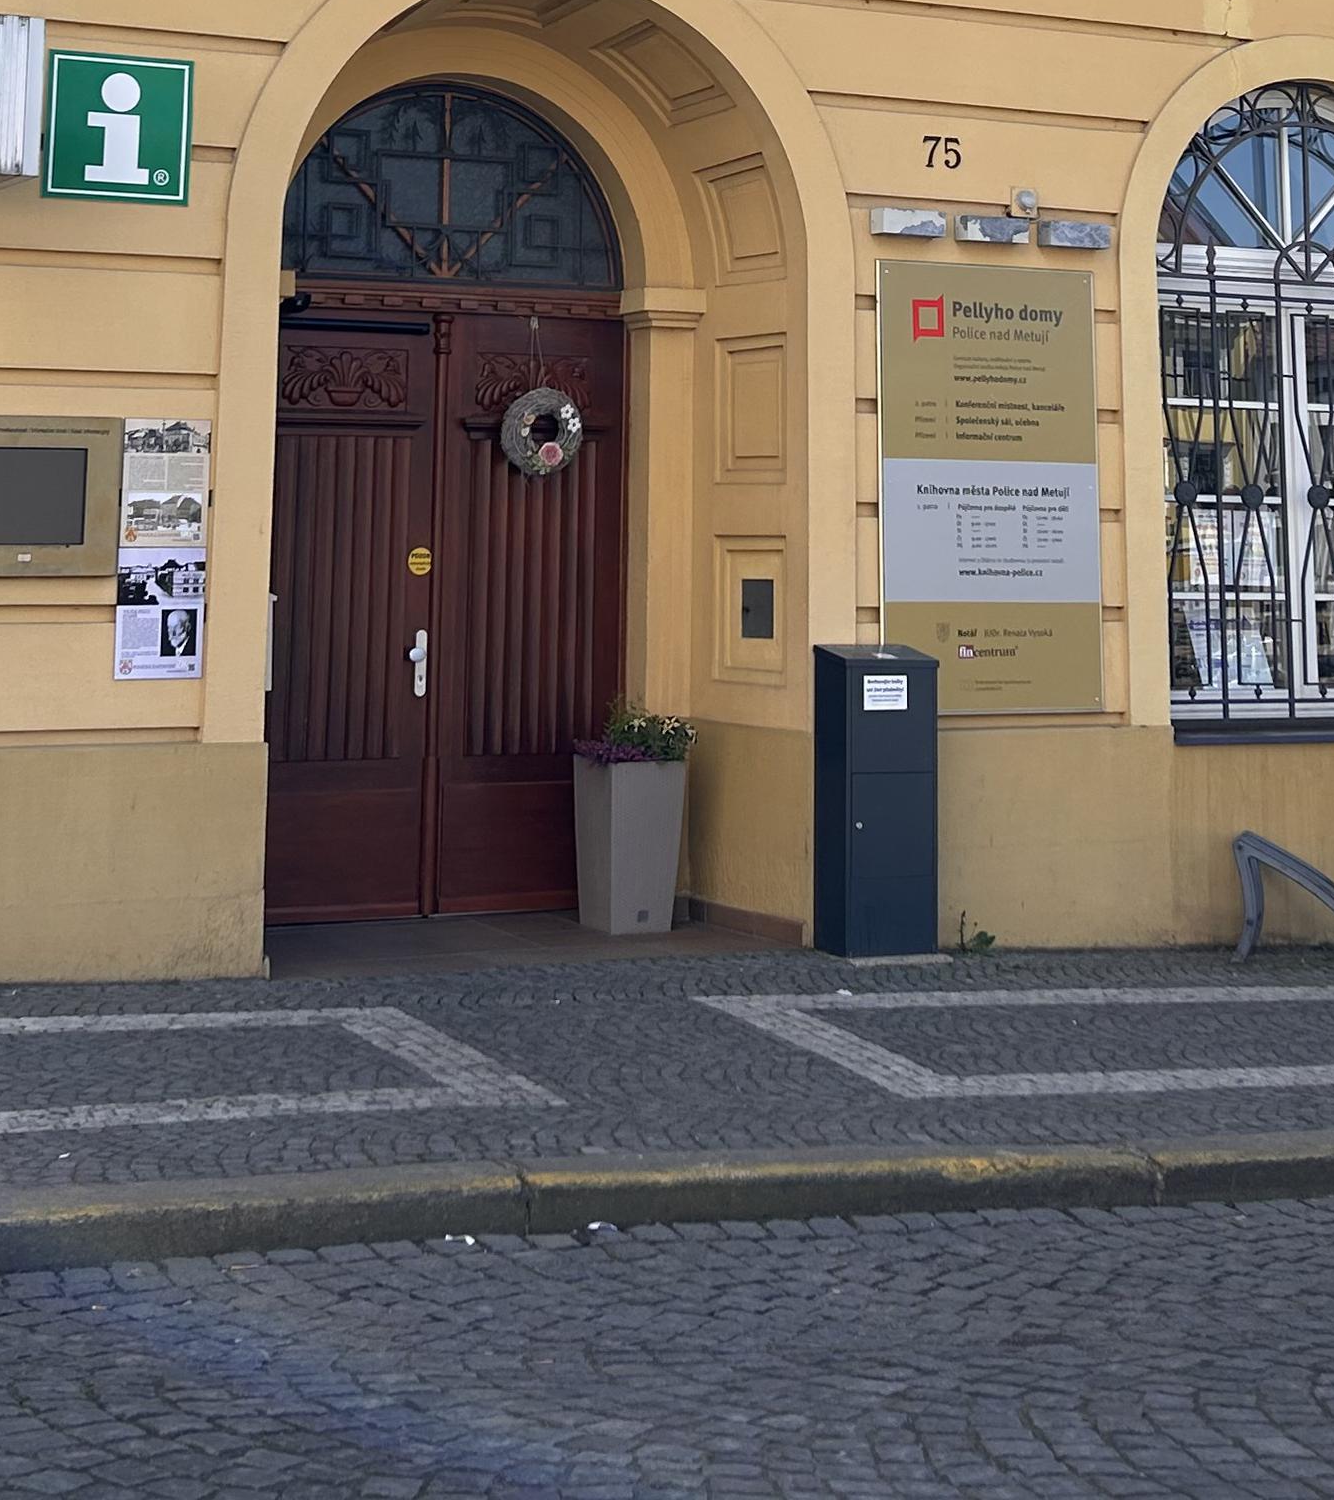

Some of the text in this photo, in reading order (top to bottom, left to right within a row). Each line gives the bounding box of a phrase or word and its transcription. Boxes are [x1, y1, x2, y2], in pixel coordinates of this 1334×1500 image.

[923, 135, 961, 169] 75
[952, 301, 1063, 327] Pellyho domy
[952, 326, 1050, 345] Police nad Metují
[955, 400, 997, 409] Konferenční
[956, 415, 999, 427] Společenský
[956, 432, 1023, 442] Informační centrum
[917, 484, 1070, 499] Knihovna města Police nad Metují
[959, 568, 1043, 578] www.knihovna-police.cz
